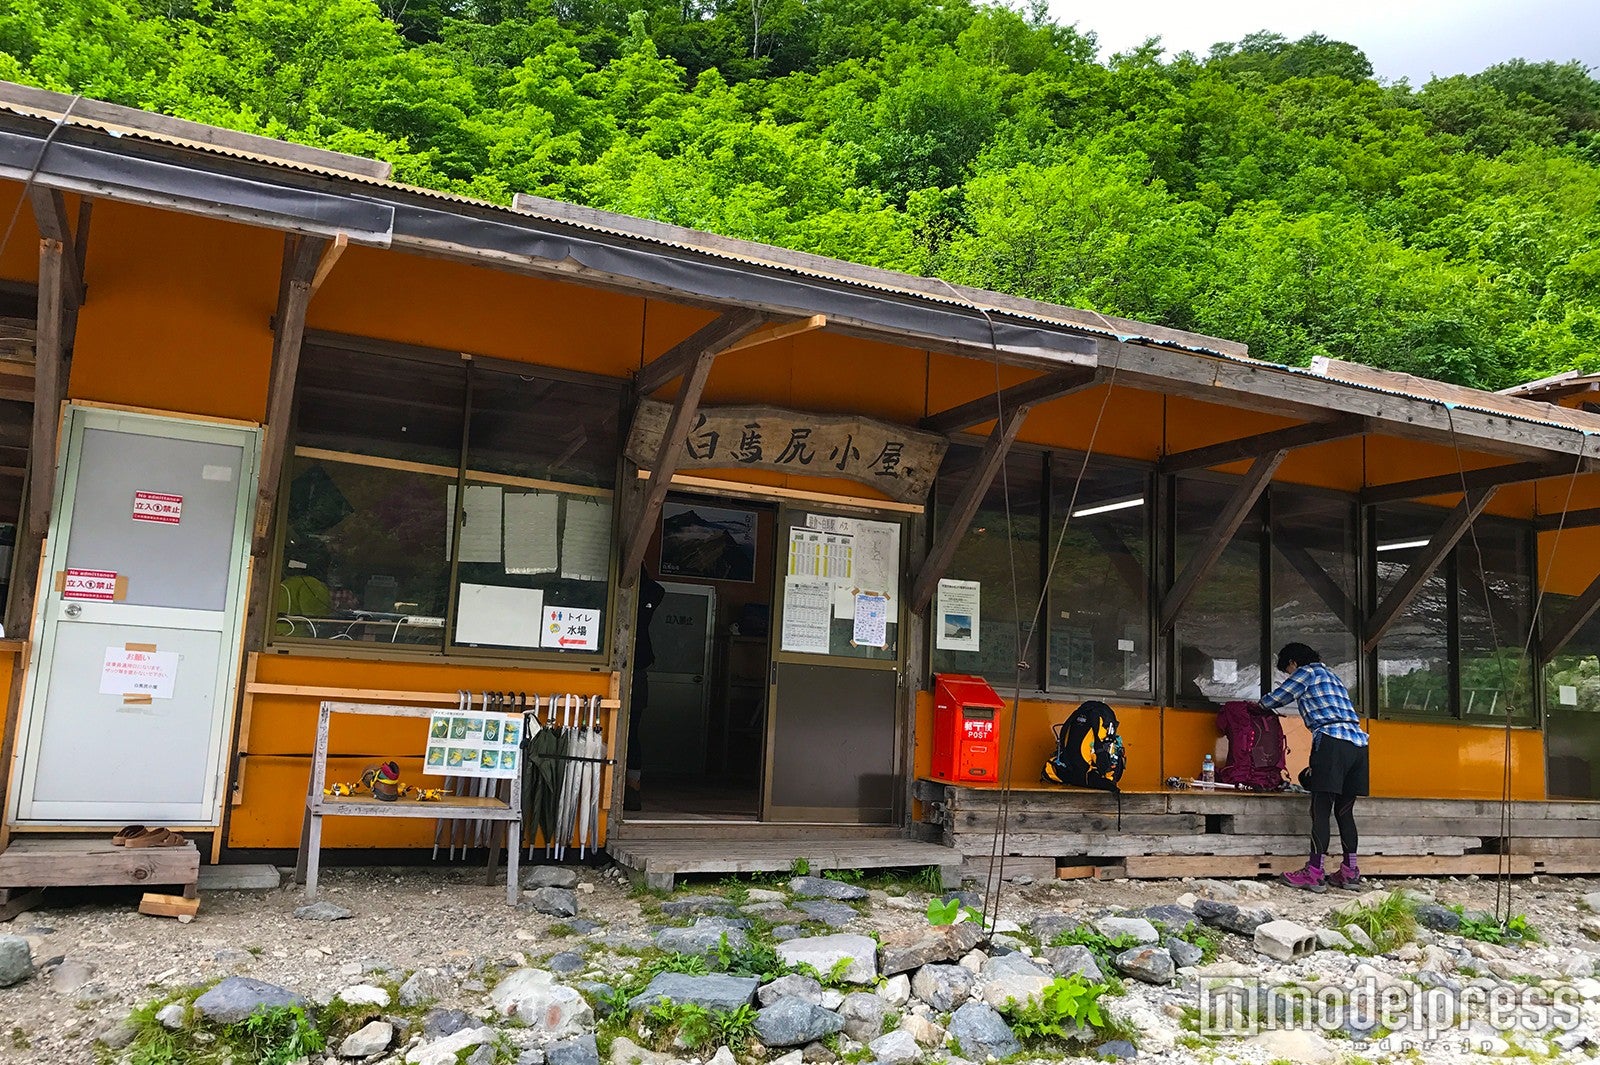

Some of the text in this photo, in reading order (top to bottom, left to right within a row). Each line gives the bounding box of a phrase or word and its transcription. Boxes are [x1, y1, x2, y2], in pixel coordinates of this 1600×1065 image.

[685, 413, 906, 479] 白馬尻小屋
[568, 612, 593, 623] トイレ
[567, 625, 588, 636] 水場
[126, 653, 151, 662] お願い
[968, 731, 988, 739] POST
